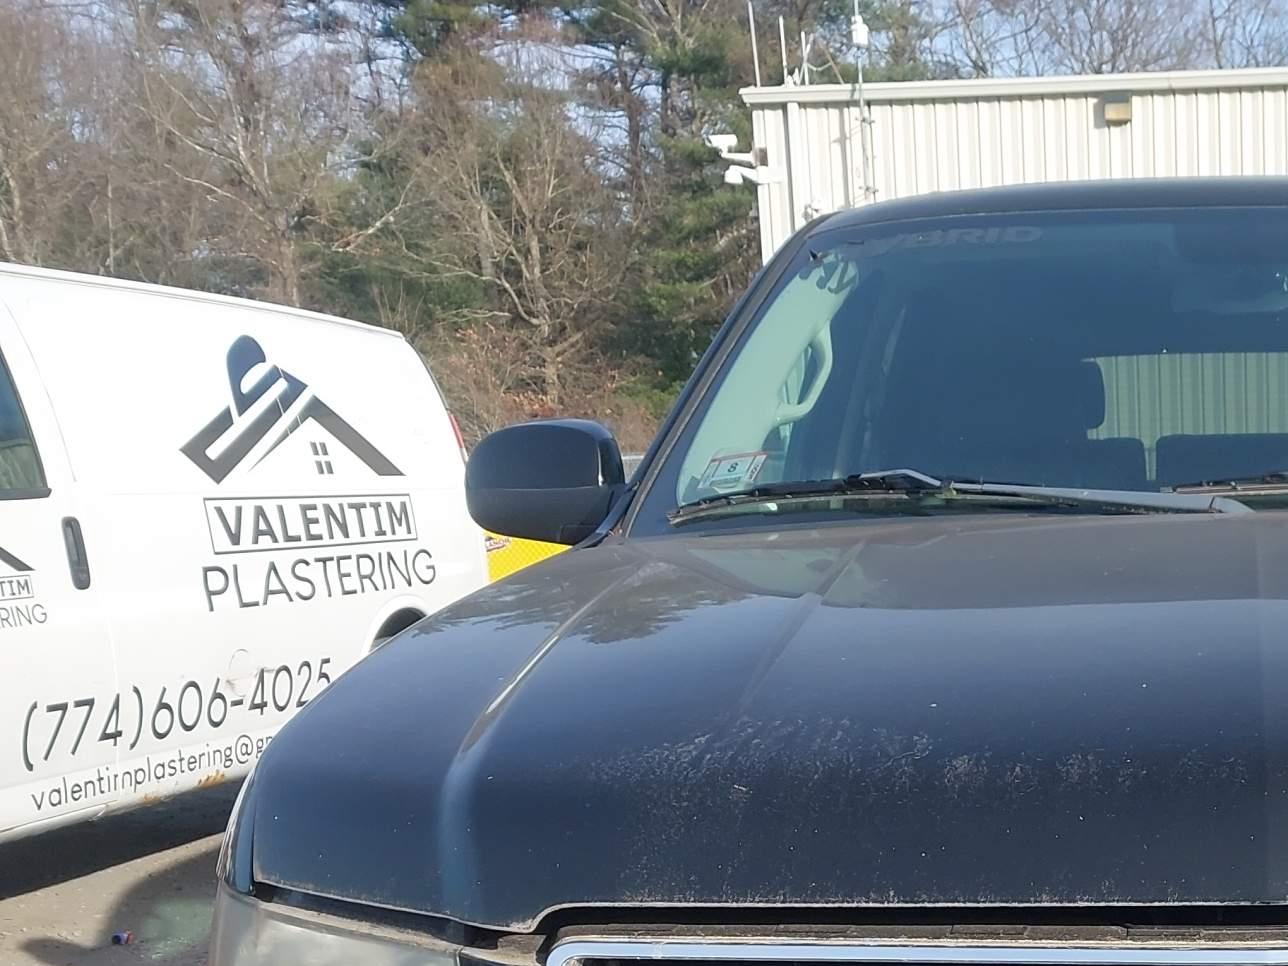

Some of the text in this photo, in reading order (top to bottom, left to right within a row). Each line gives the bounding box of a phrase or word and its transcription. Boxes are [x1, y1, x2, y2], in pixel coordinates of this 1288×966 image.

[213, 500, 412, 546] VALENTIM
[202, 548, 436, 612] PLASTERING
[22, 657, 331, 772] (774)606-4025
